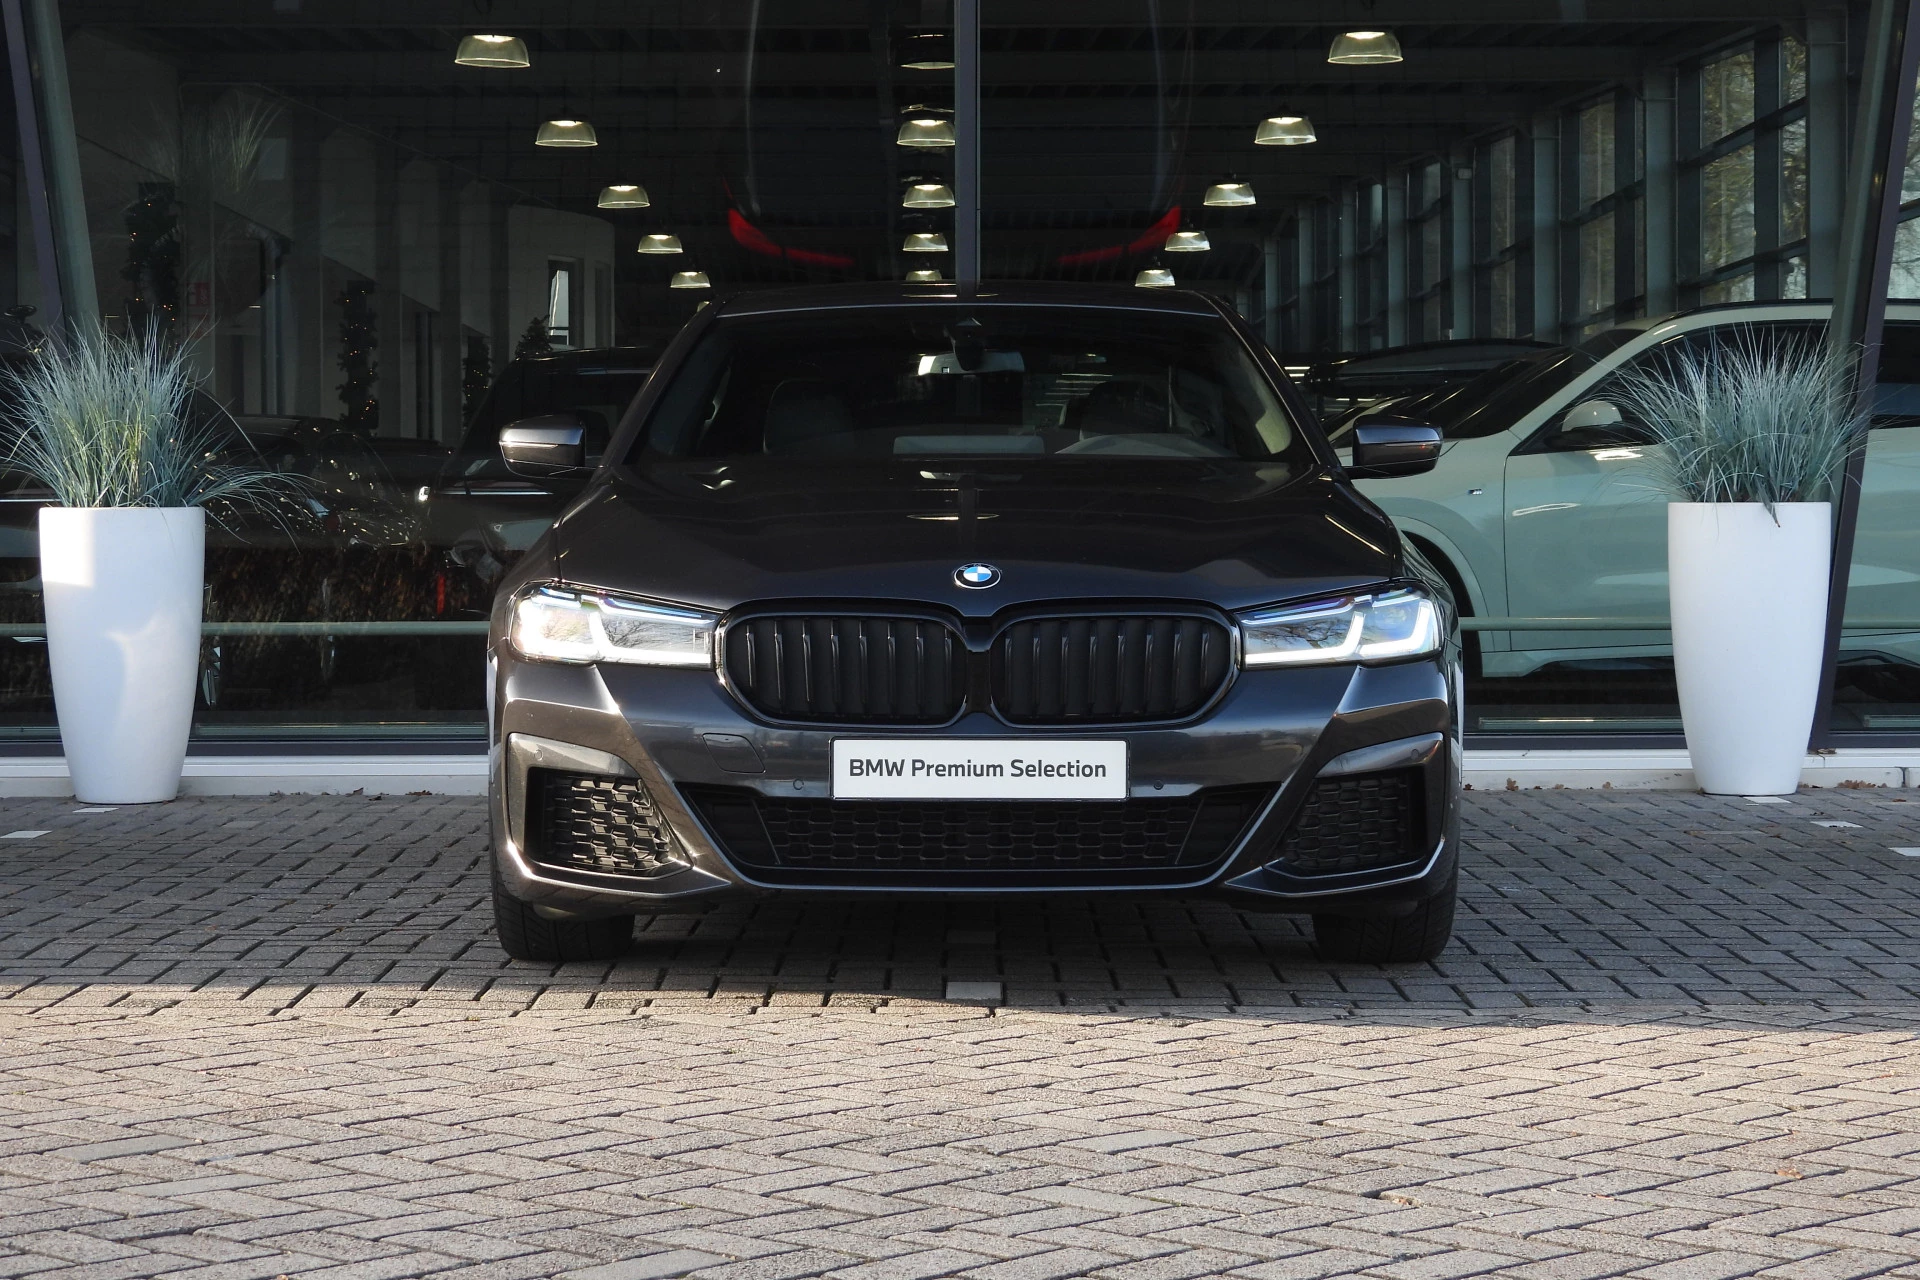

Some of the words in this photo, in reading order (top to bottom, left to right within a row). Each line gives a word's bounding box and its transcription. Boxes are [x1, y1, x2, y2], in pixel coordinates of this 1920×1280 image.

[849, 758, 906, 777] BMW
[911, 758, 1004, 778] Premium
[1010, 758, 1107, 778] Selection
